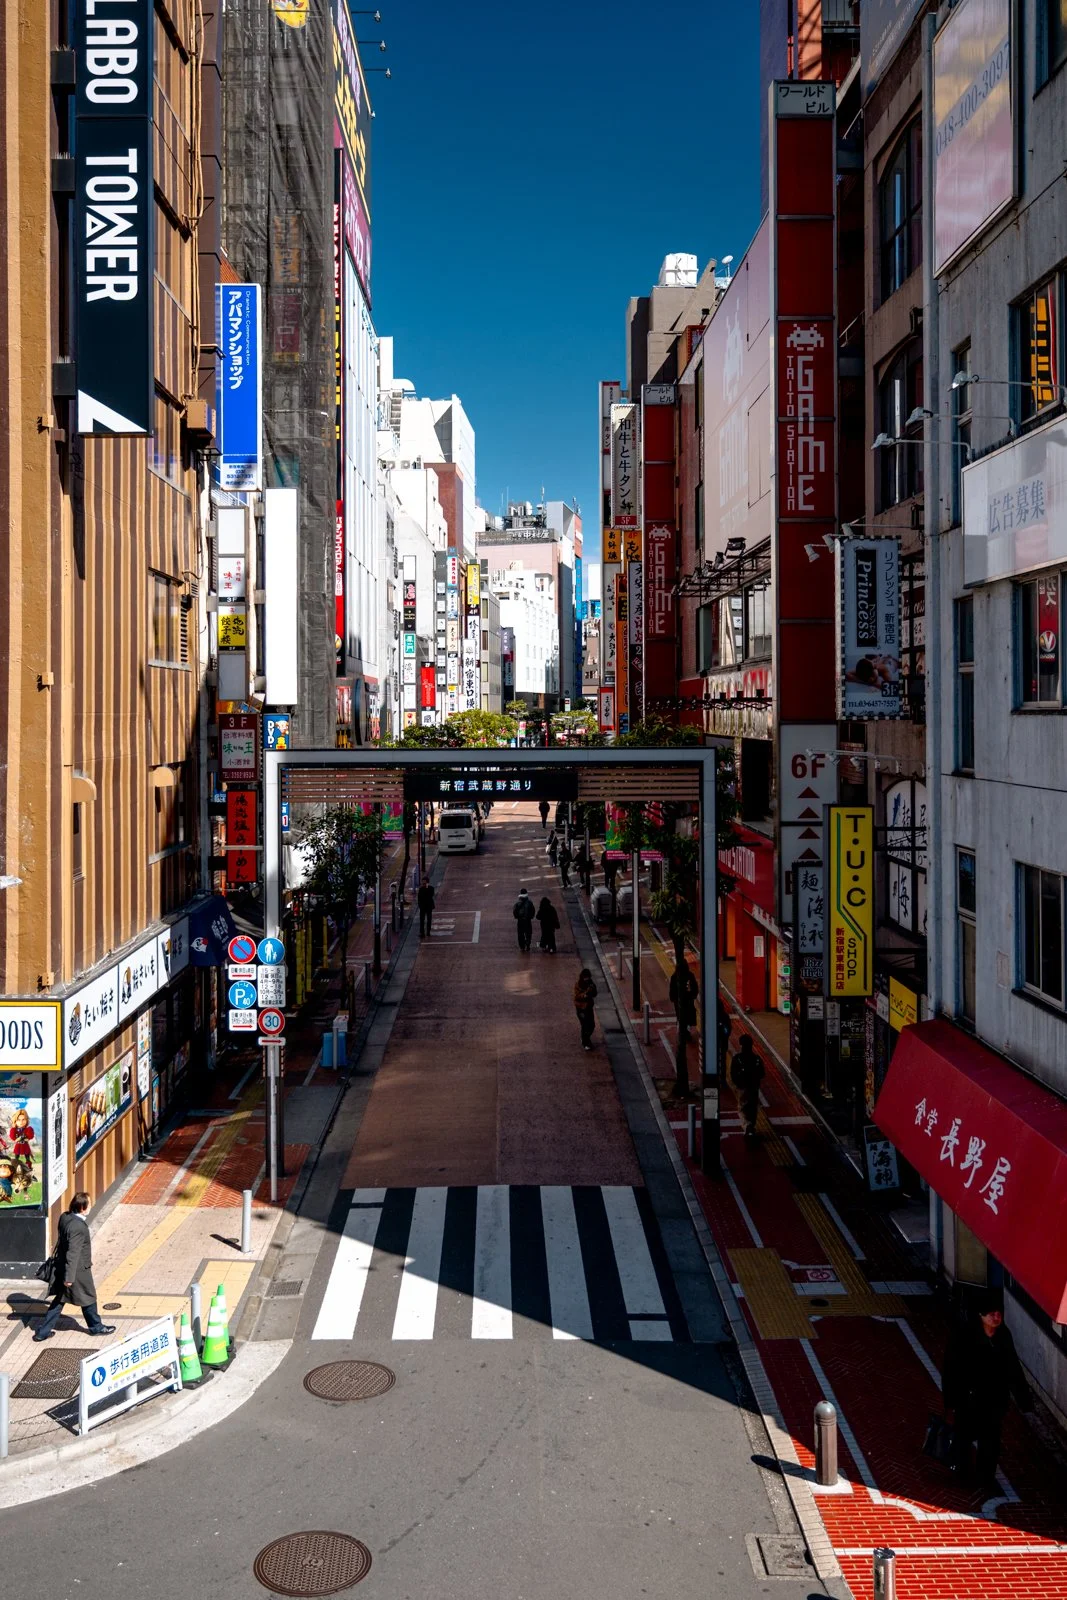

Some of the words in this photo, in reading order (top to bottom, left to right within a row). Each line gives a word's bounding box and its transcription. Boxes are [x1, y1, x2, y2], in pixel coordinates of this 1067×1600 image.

[779, 85, 827, 98] ワールド
[806, 101, 830, 113] ビル
[86, 148, 138, 302] TOWER
[229, 291, 244, 390] アパマンショップ
[786, 355, 795, 416] TAITO
[797, 355, 825, 511] GAME
[618, 418, 631, 498] 和牛と牛タン
[786, 425, 795, 511] STATION
[620, 516, 631, 527] 5F
[989, 480, 1044, 534] 広告募集
[655, 543, 671, 634] GAME
[857, 560, 872, 639] Princess
[884, 551, 895, 607] リフレッシュ
[884, 614, 895, 644] 新宿店
[883, 683, 898, 697] 3F
[439, 779, 532, 791] 新宿武蔵野通り
[791, 754, 826, 779] 6F
[836, 928, 845, 990] 新宿駅東南口店
[848, 937, 857, 980] SHOP
[85, 988, 113, 1028] たい焼き
[264, 1015, 280, 1028] 30
[914, 1097, 938, 1137] 食堂
[940, 1117, 1012, 1216] 長野屋
[110, 1332, 170, 1376] 歩行者用道路
